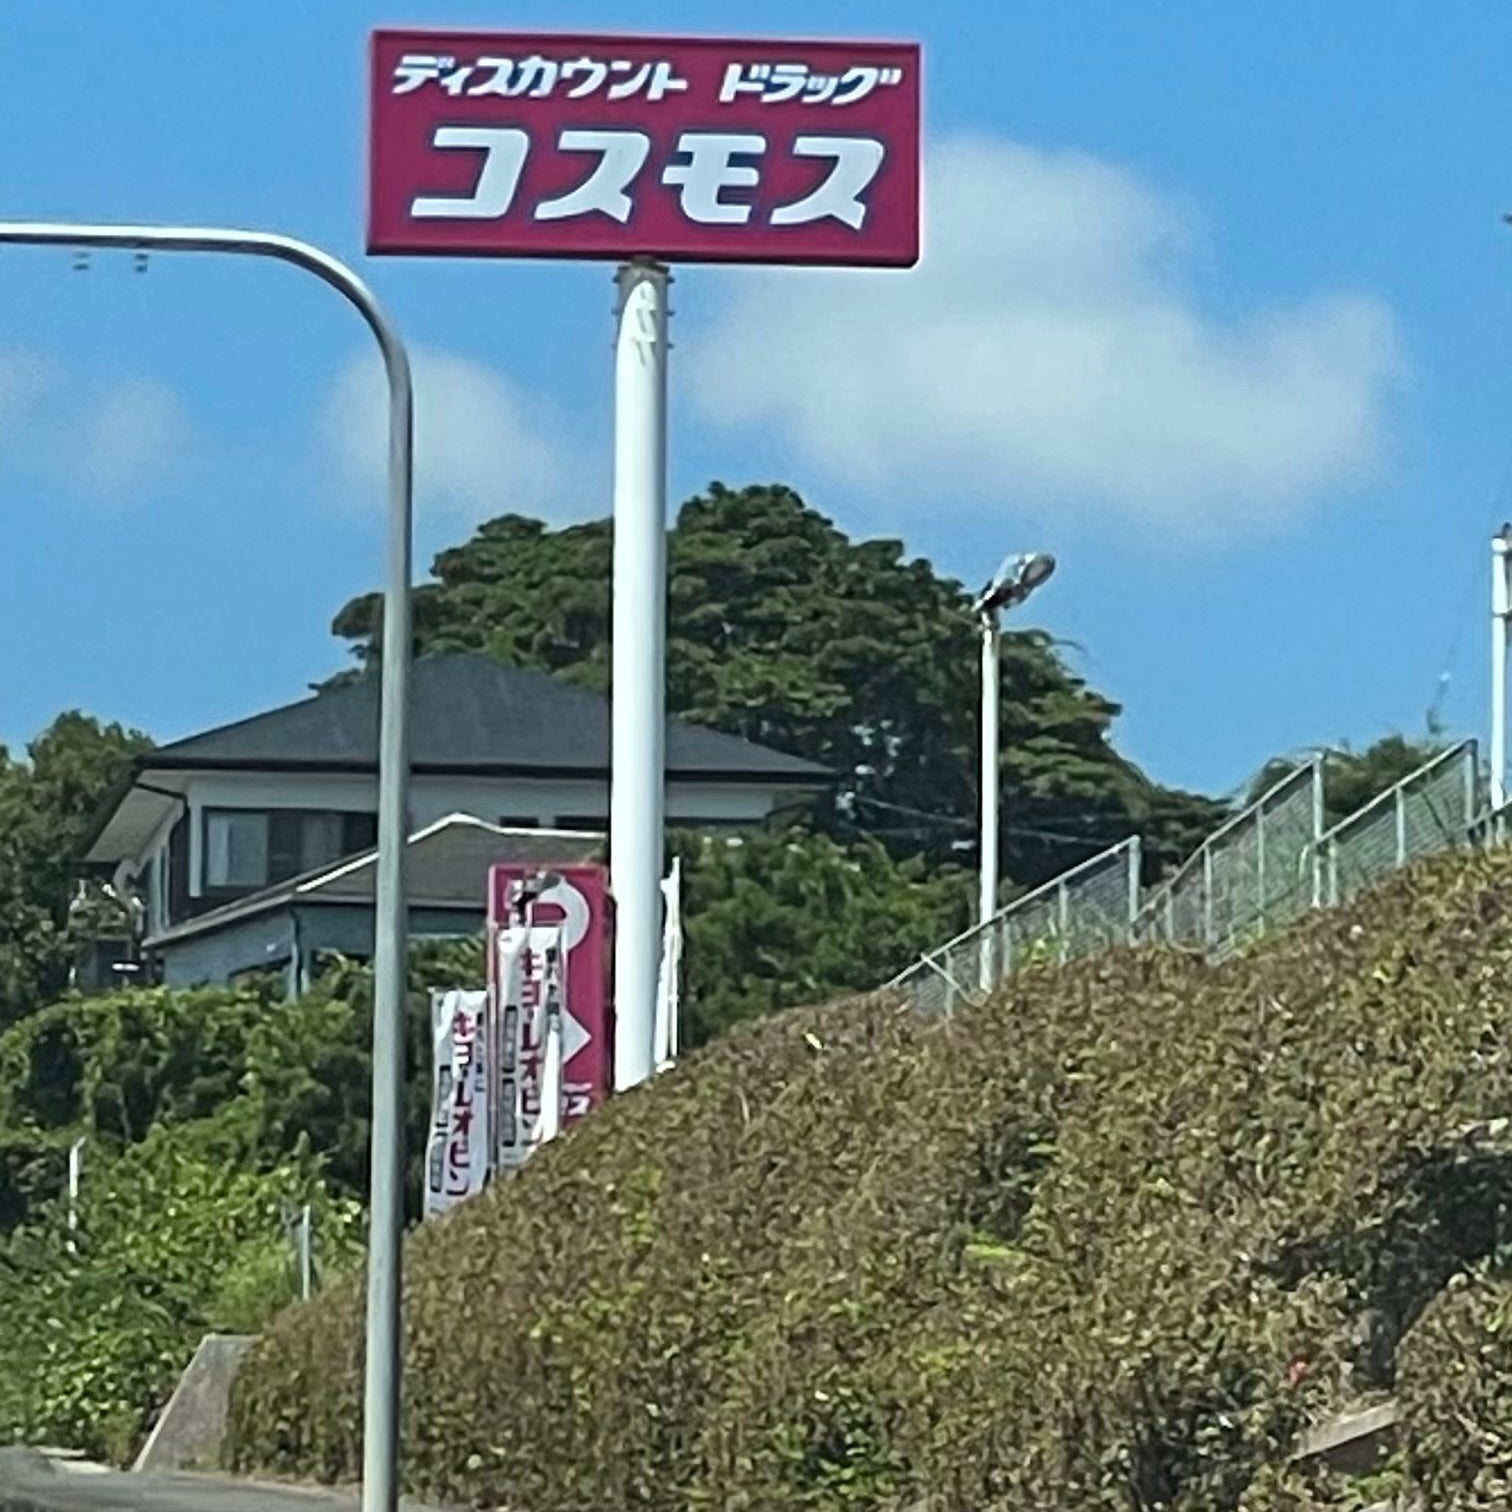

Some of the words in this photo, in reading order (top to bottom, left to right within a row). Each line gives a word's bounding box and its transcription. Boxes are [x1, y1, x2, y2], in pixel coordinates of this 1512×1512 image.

[392, 54, 688, 101] ディスカウント
[718, 61, 903, 106] ドラッグ
[409, 126, 886, 230] コスモス
